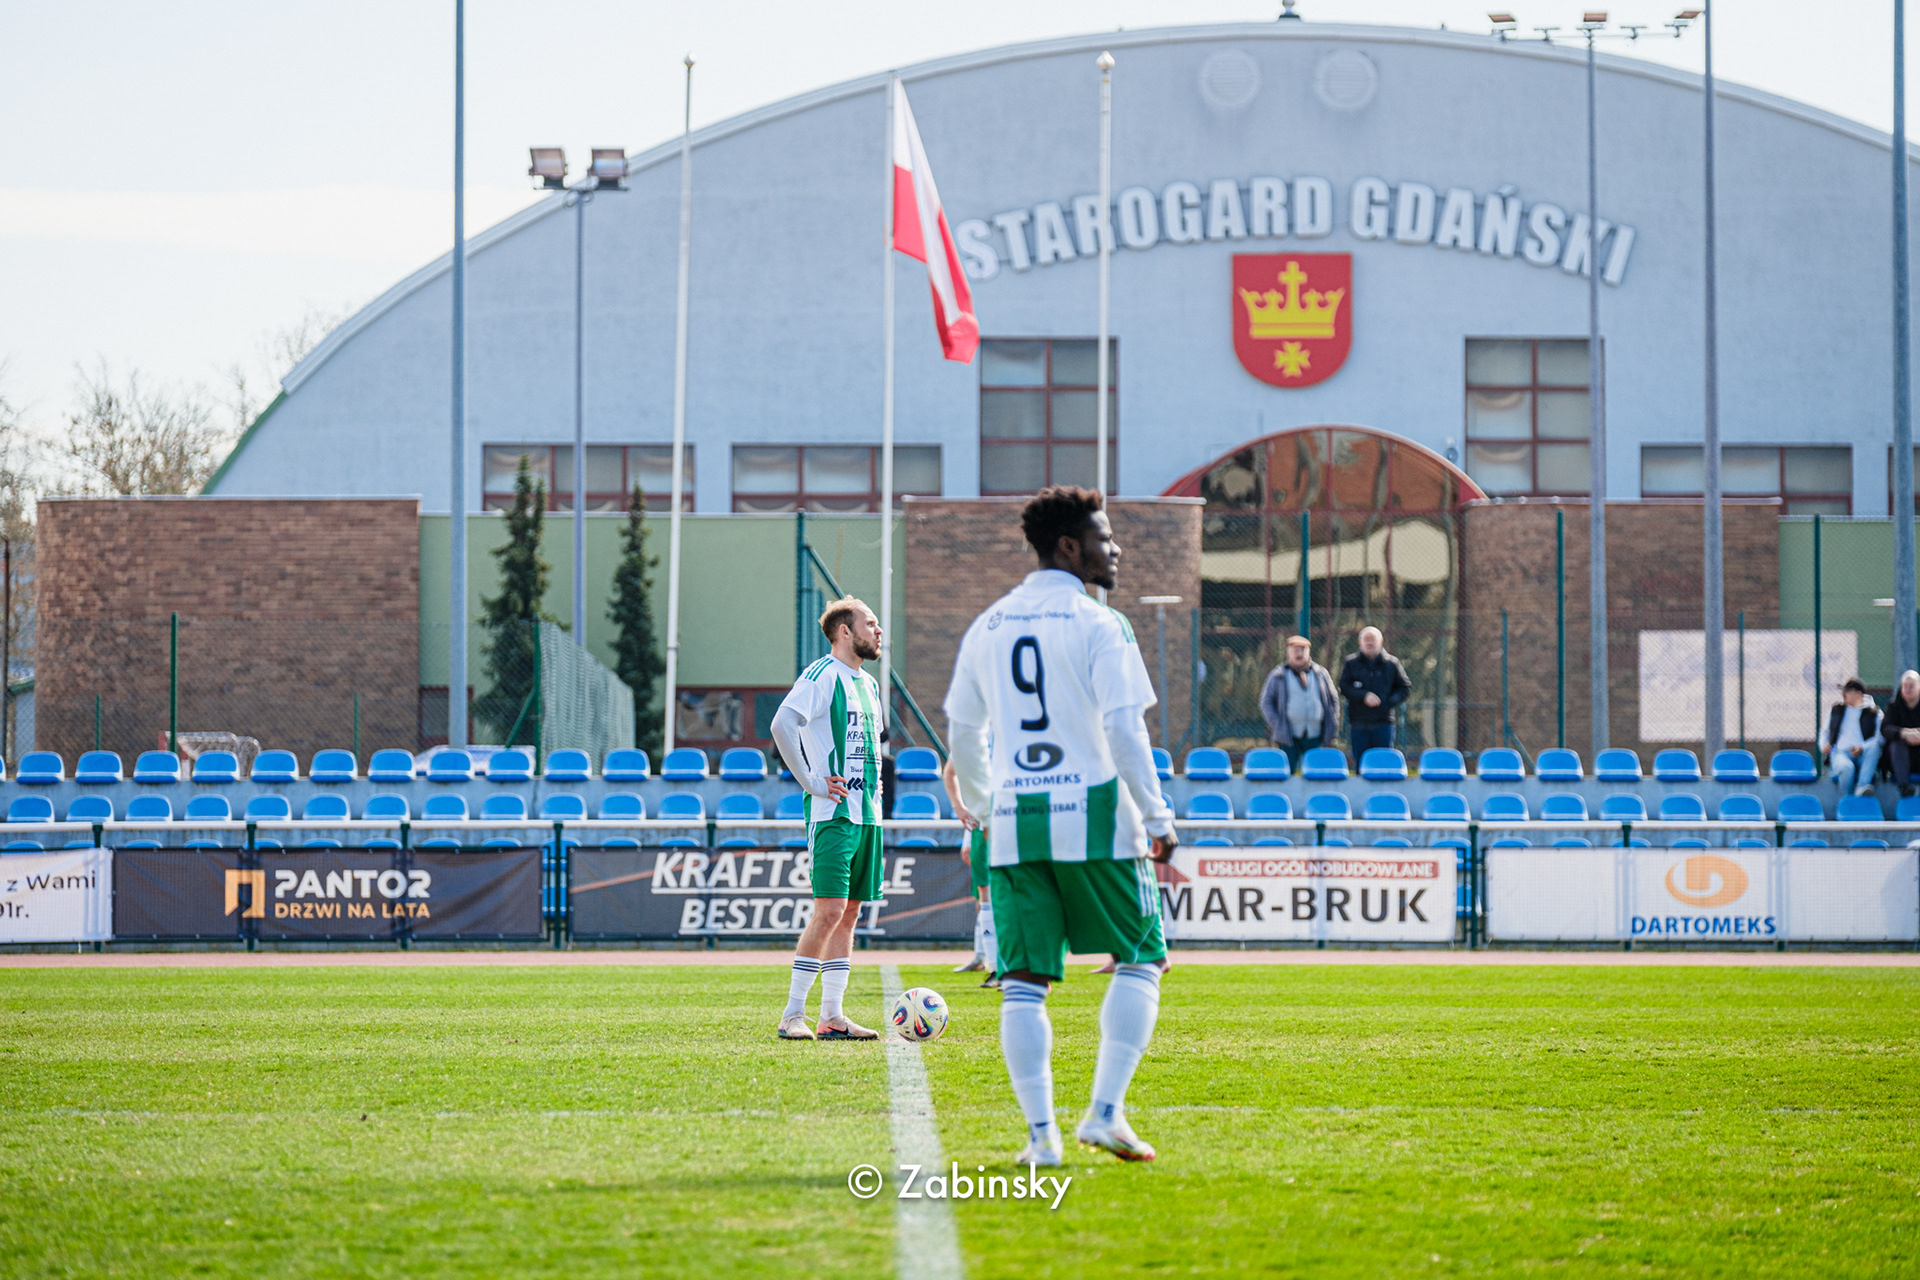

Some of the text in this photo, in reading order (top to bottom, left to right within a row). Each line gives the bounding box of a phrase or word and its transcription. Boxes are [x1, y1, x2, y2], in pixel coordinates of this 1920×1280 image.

[956, 175, 1636, 286] STAROGARD GDAŃSKI
[1012, 636, 1049, 731] 9
[7, 870, 96, 892] z Wami
[275, 869, 432, 899] PANTOR
[1205, 860, 1435, 878] USŁUGI OGÓLNOBUDOWLANE
[275, 903, 432, 918] DRZWI NA LATA
[681, 897, 889, 930] BESTCRT
[1160, 887, 1428, 922] MAR-BRUK
[1632, 916, 1776, 935] DARTOMEKS
